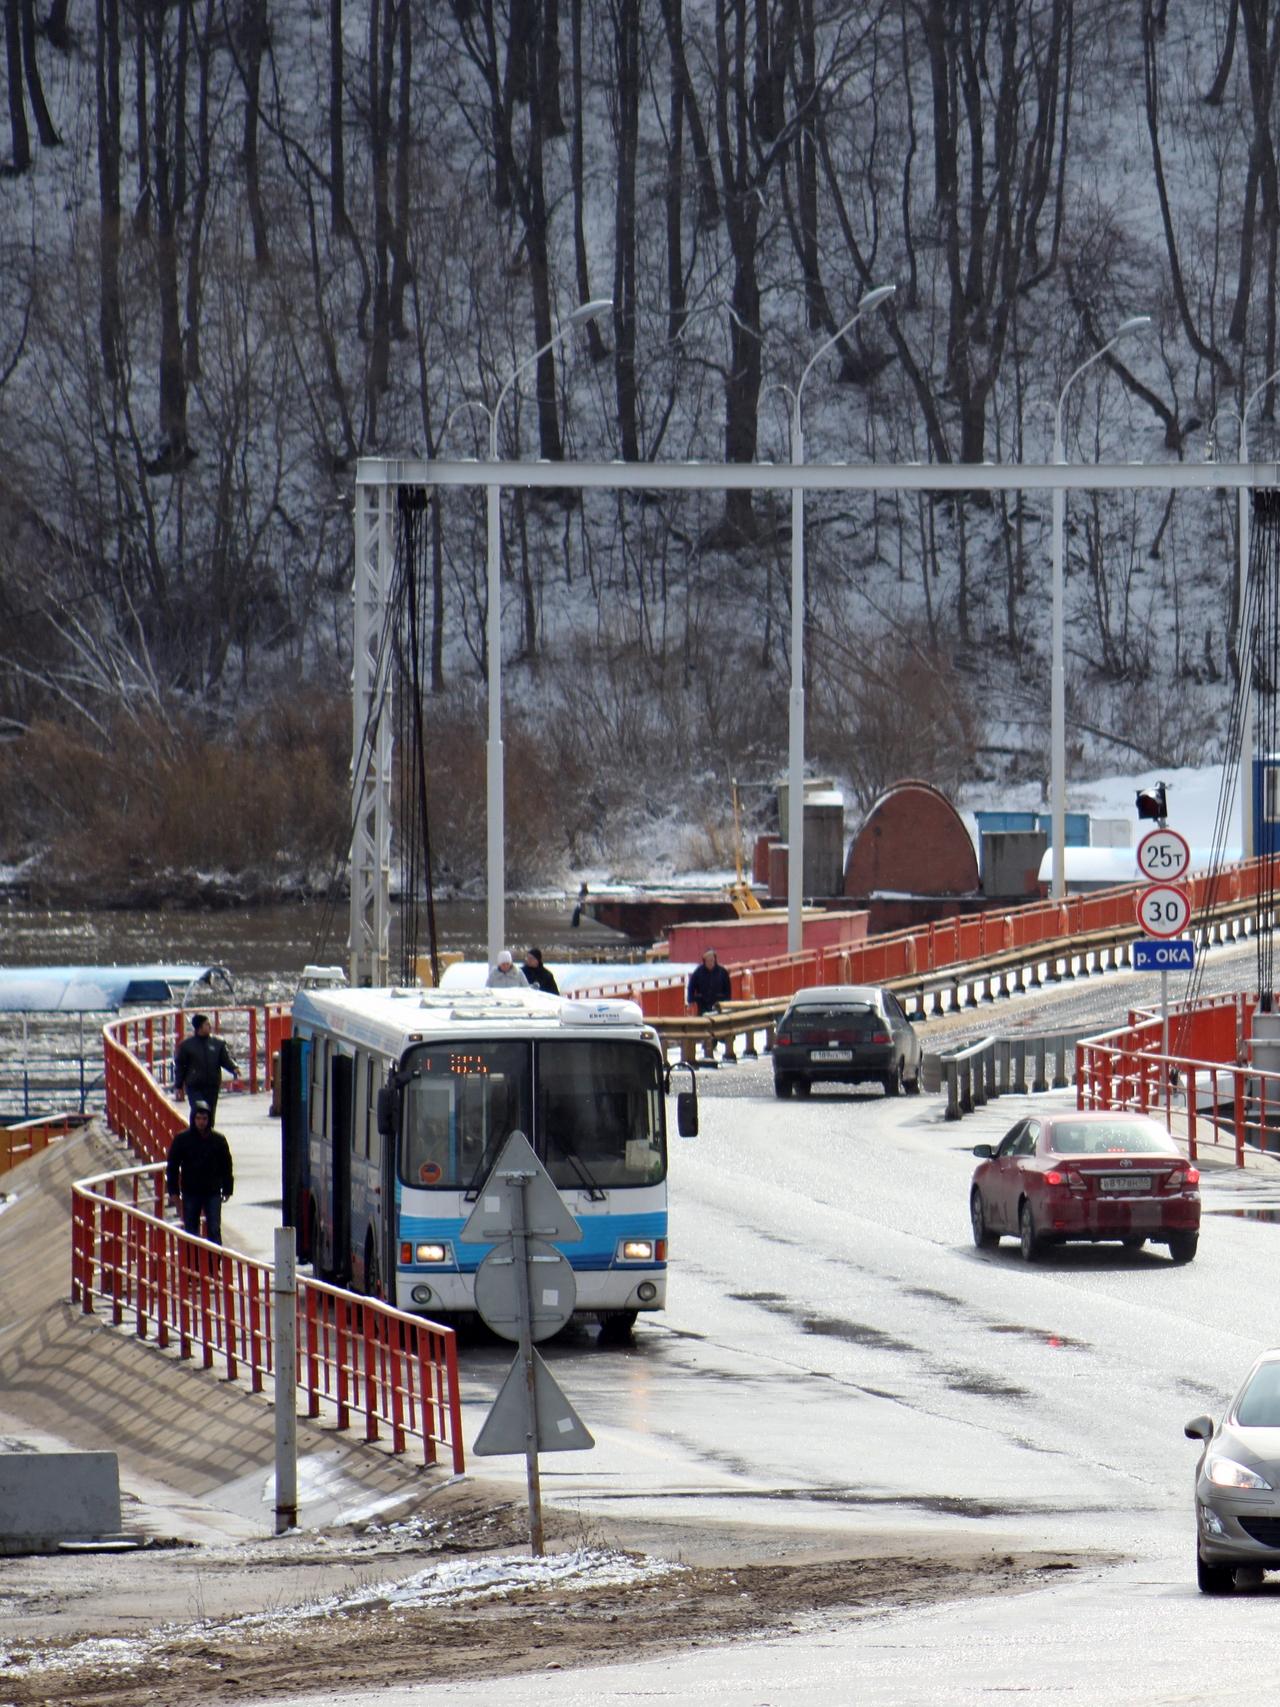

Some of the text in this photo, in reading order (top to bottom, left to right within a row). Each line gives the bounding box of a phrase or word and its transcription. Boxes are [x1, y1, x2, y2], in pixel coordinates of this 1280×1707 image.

[1147, 845, 1182, 868] 25т
[1149, 901, 1178, 922] 30
[1137, 949, 1191, 966] р. ОКА
